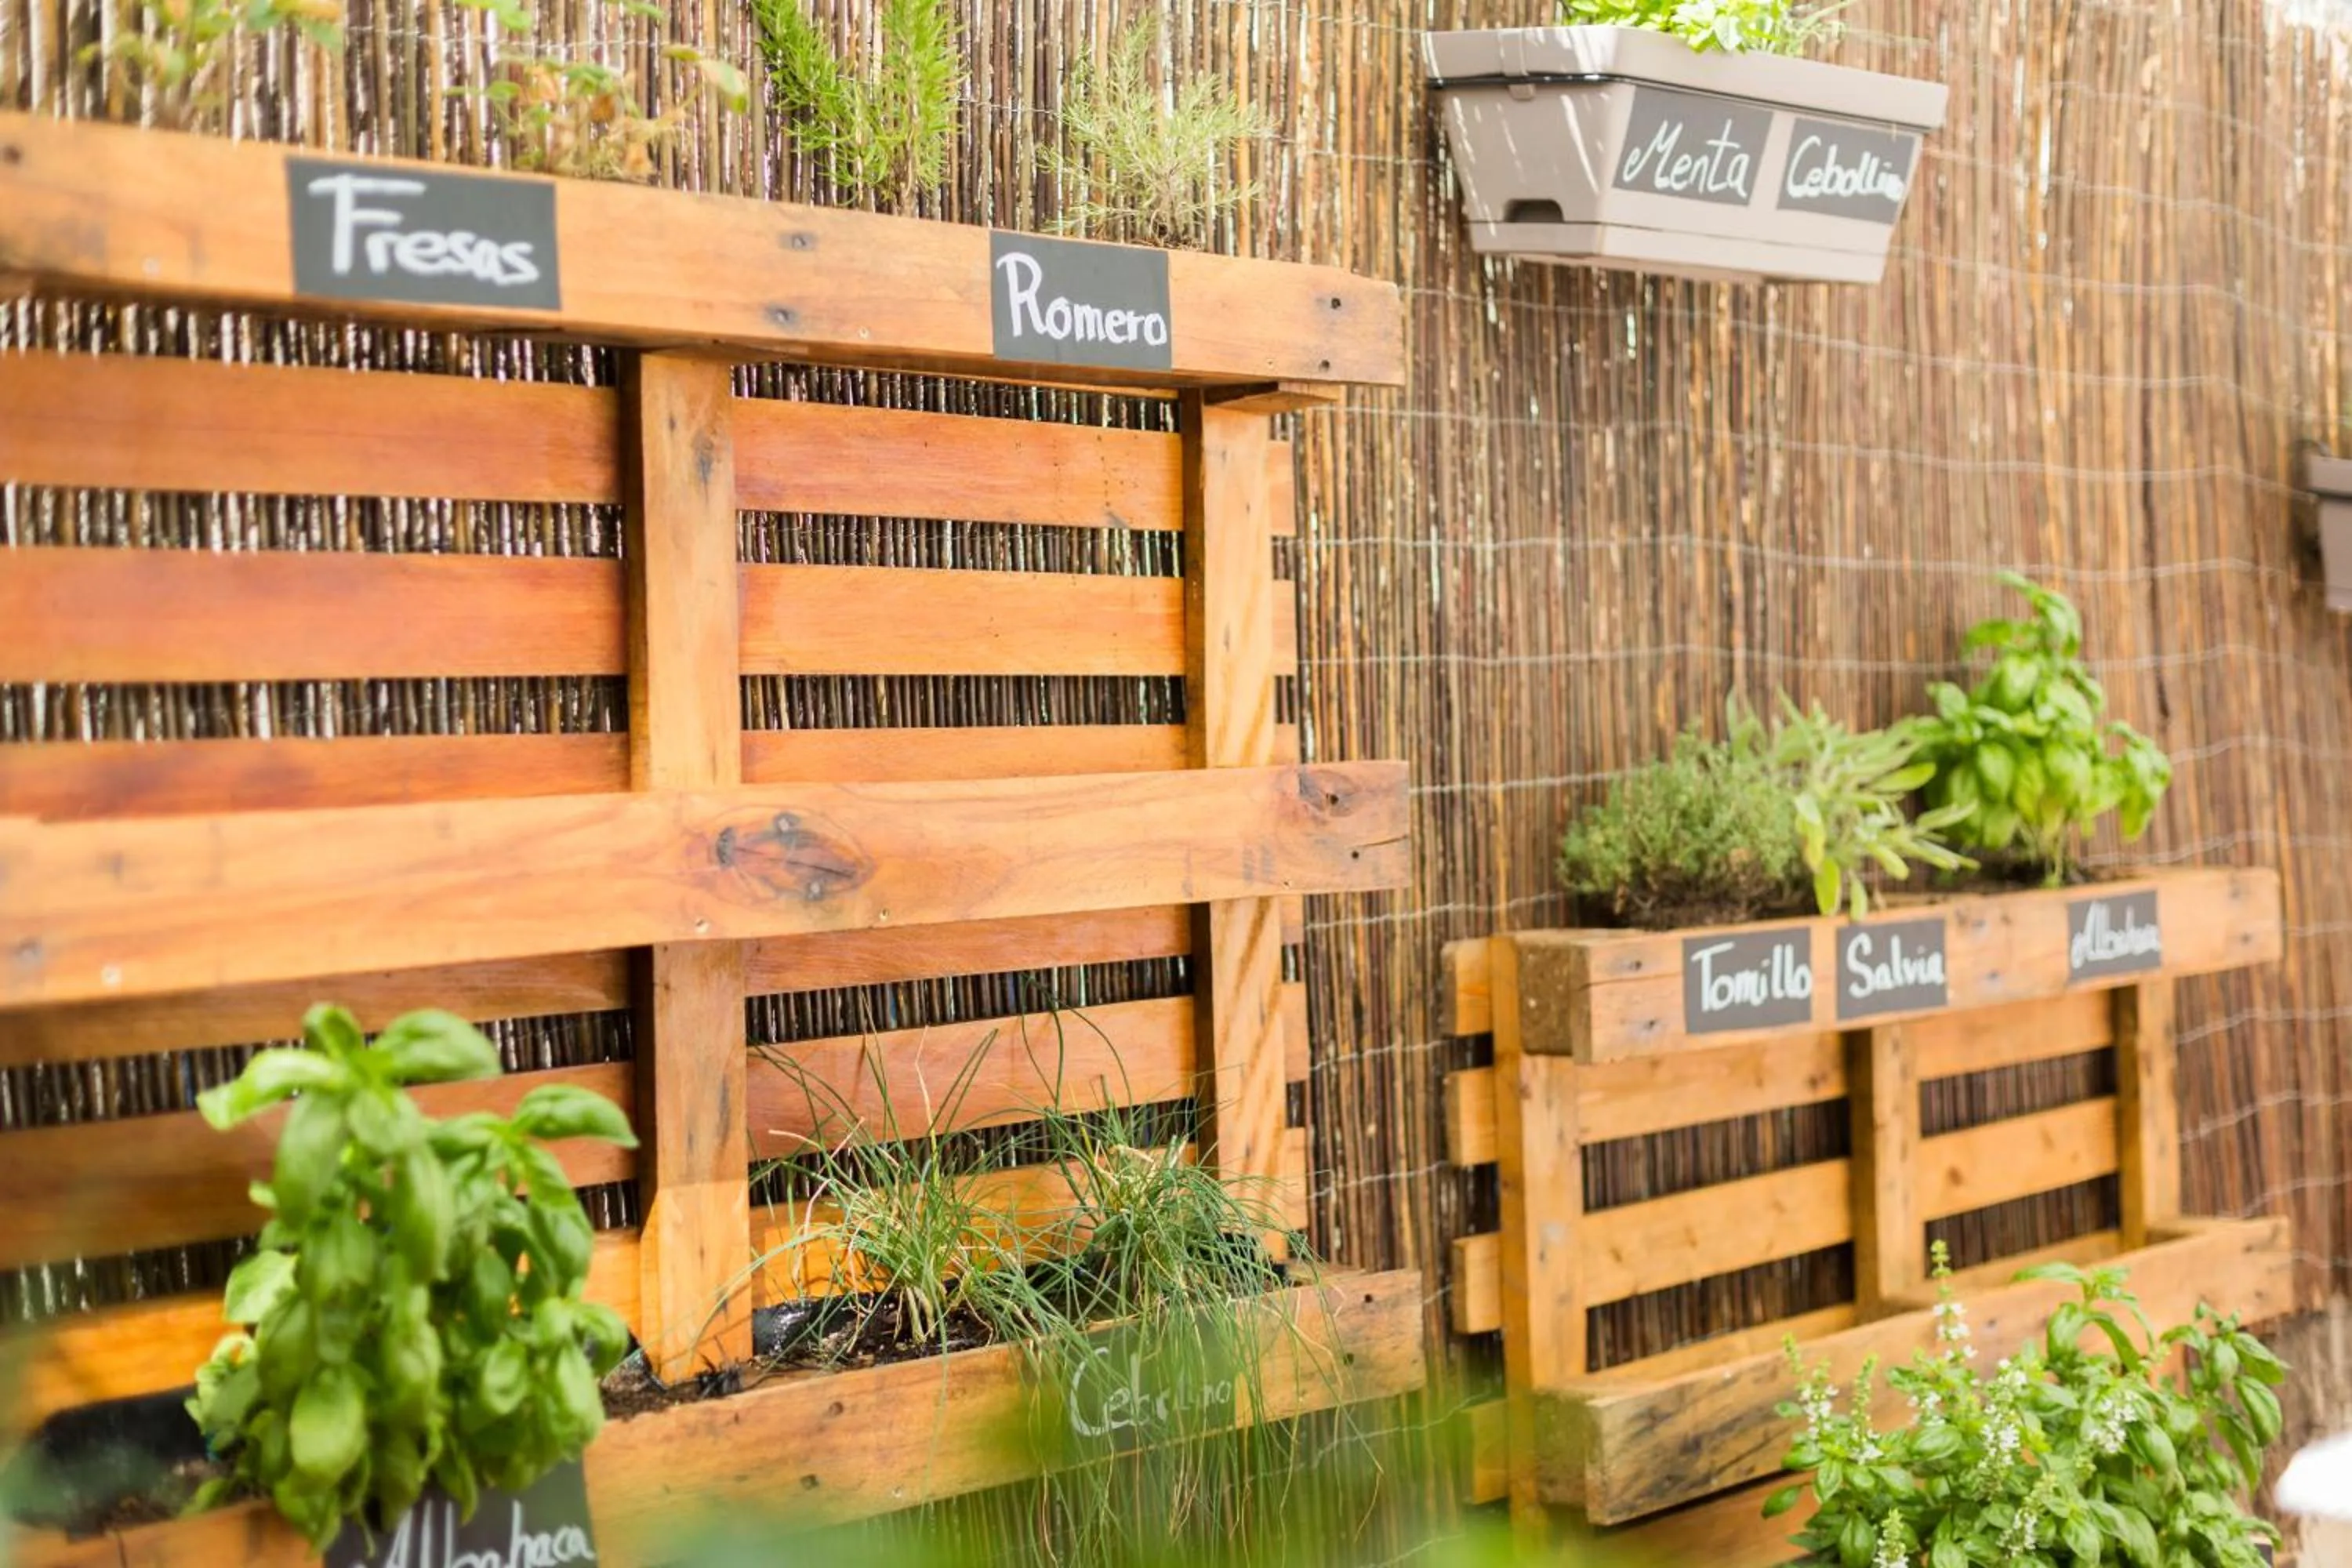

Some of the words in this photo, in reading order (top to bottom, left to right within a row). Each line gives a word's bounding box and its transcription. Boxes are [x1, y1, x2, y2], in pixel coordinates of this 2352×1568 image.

[1622, 118, 1750, 198] Menta
[308, 173, 540, 285] Fresas
[996, 252, 1168, 346] Romero
[1691, 942, 1813, 1013] Tomillo
[1847, 931, 1946, 999] Salvia
